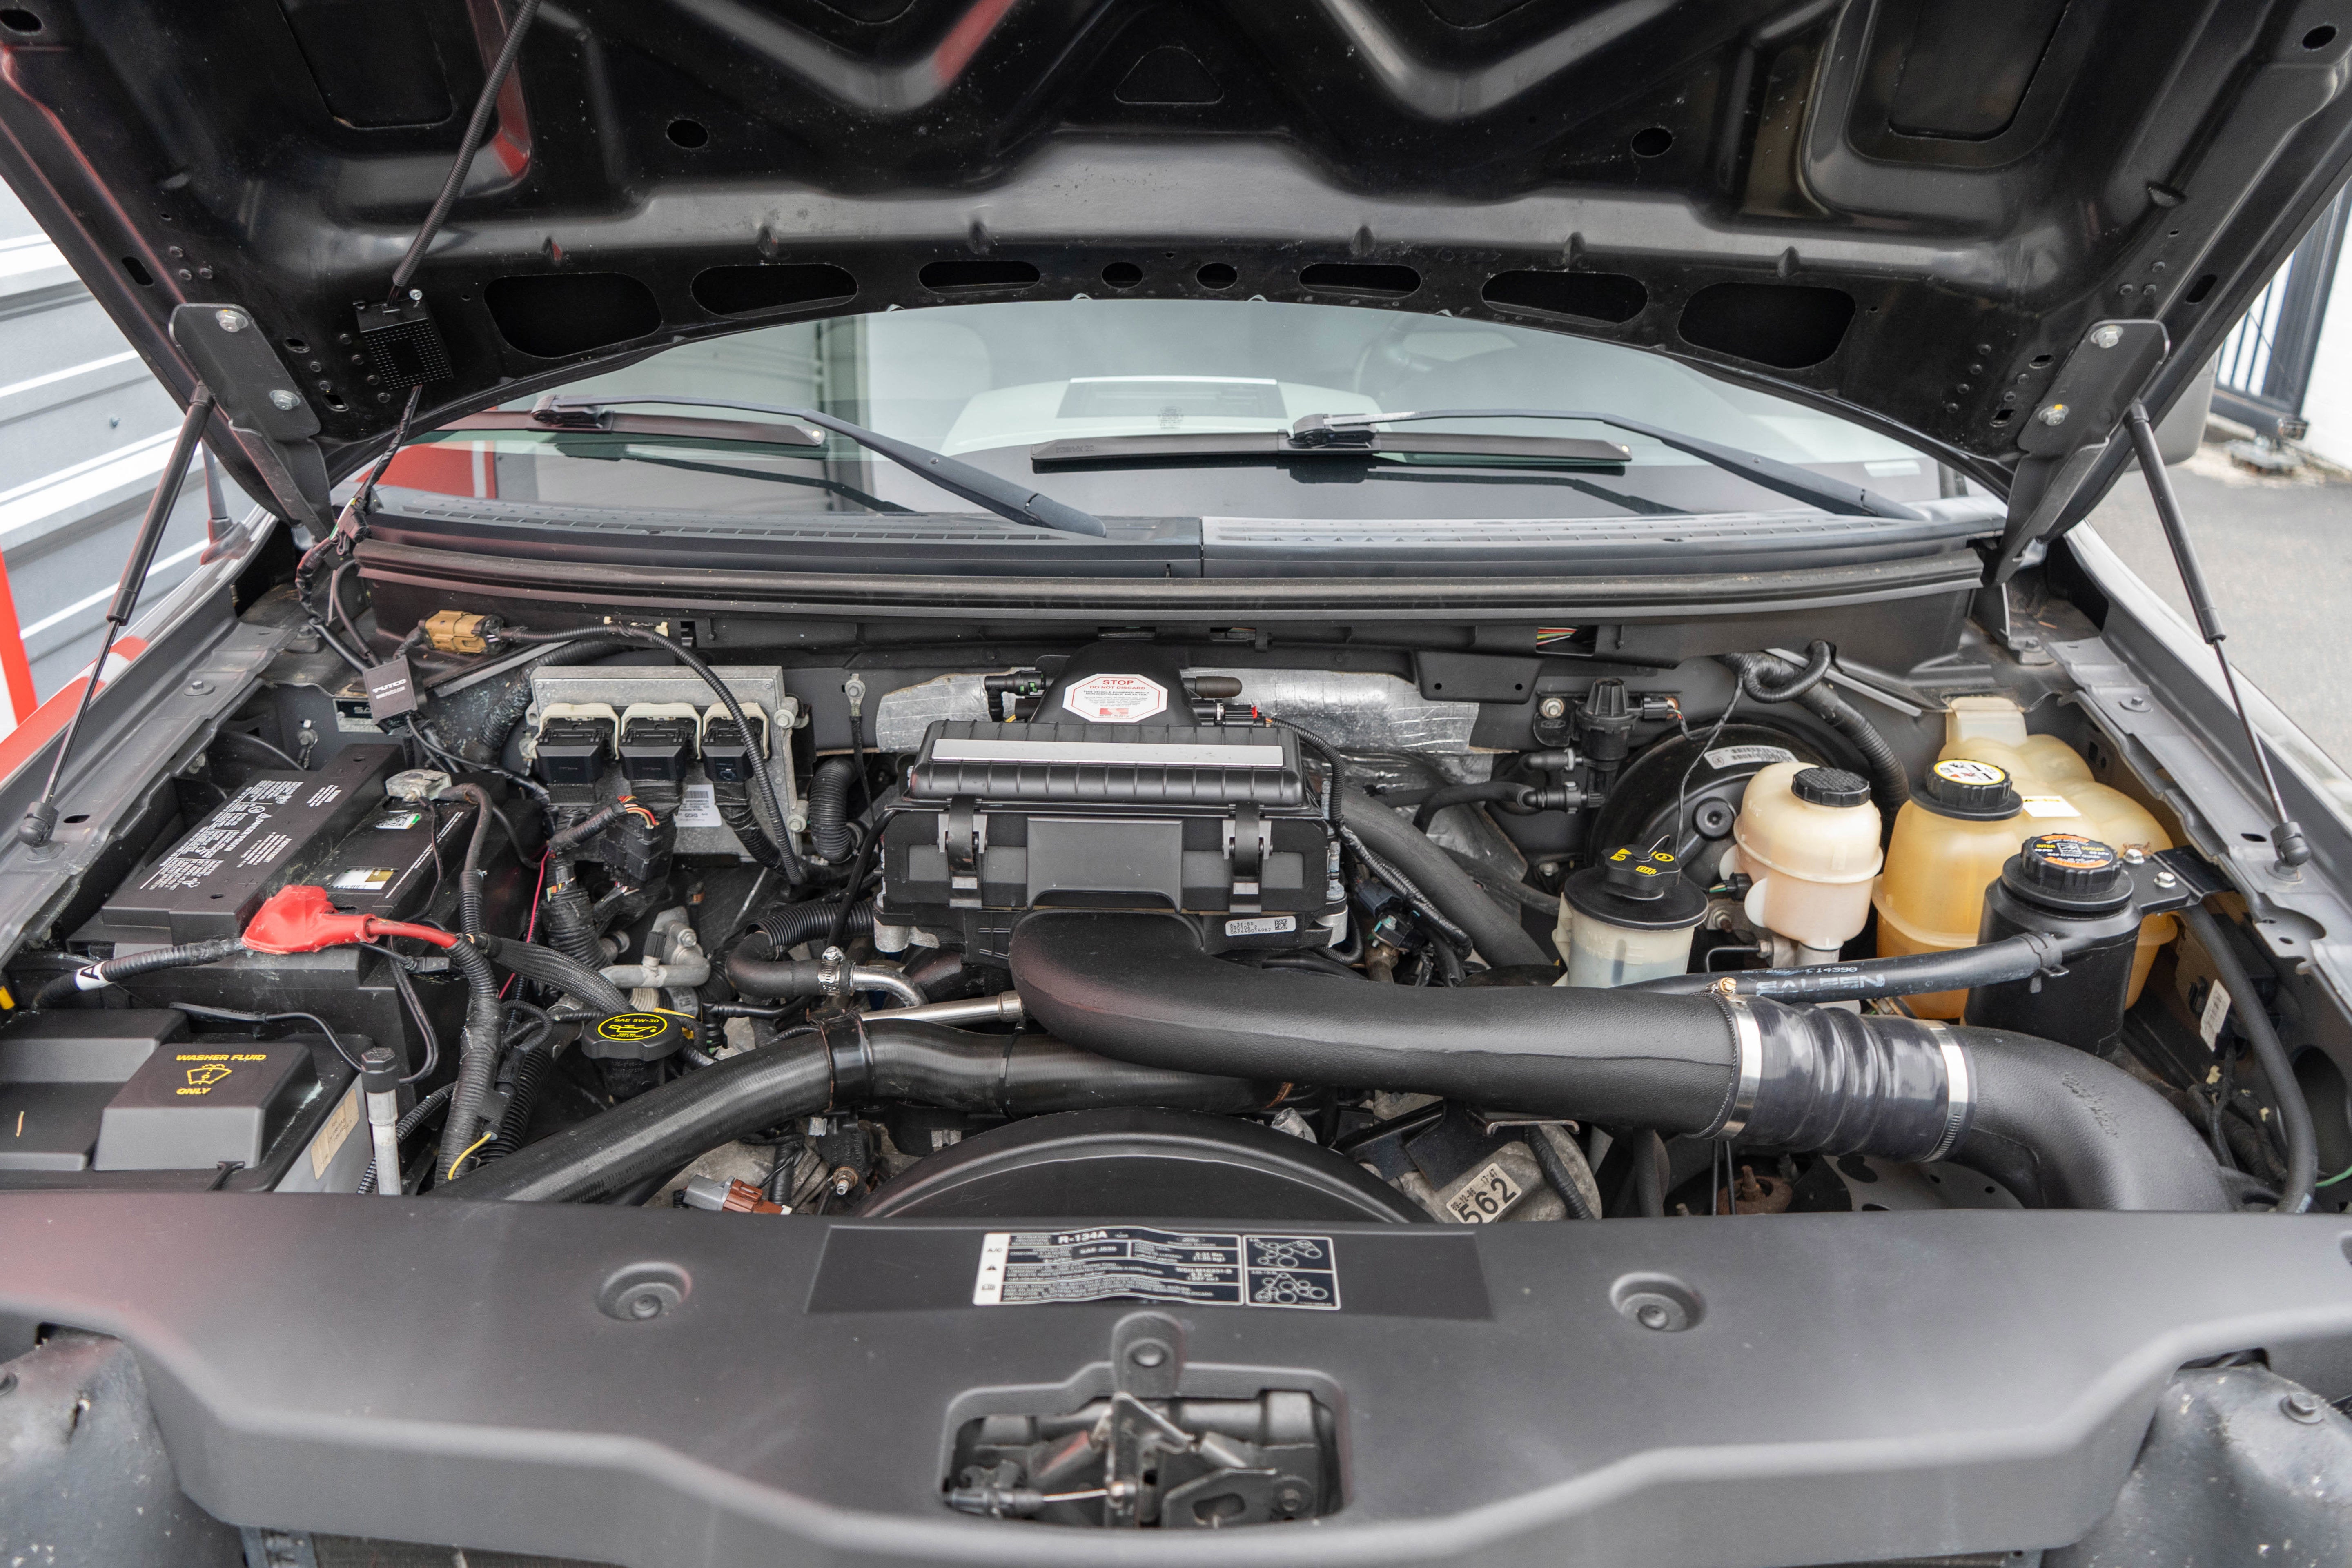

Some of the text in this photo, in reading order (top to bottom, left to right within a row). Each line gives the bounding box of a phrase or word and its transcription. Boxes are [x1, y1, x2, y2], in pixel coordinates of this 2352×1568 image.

[372, 679, 407, 693] PUTCO
[1458, 1178, 1517, 1223] 562
[1058, 1230, 1108, 1244] R-134A
